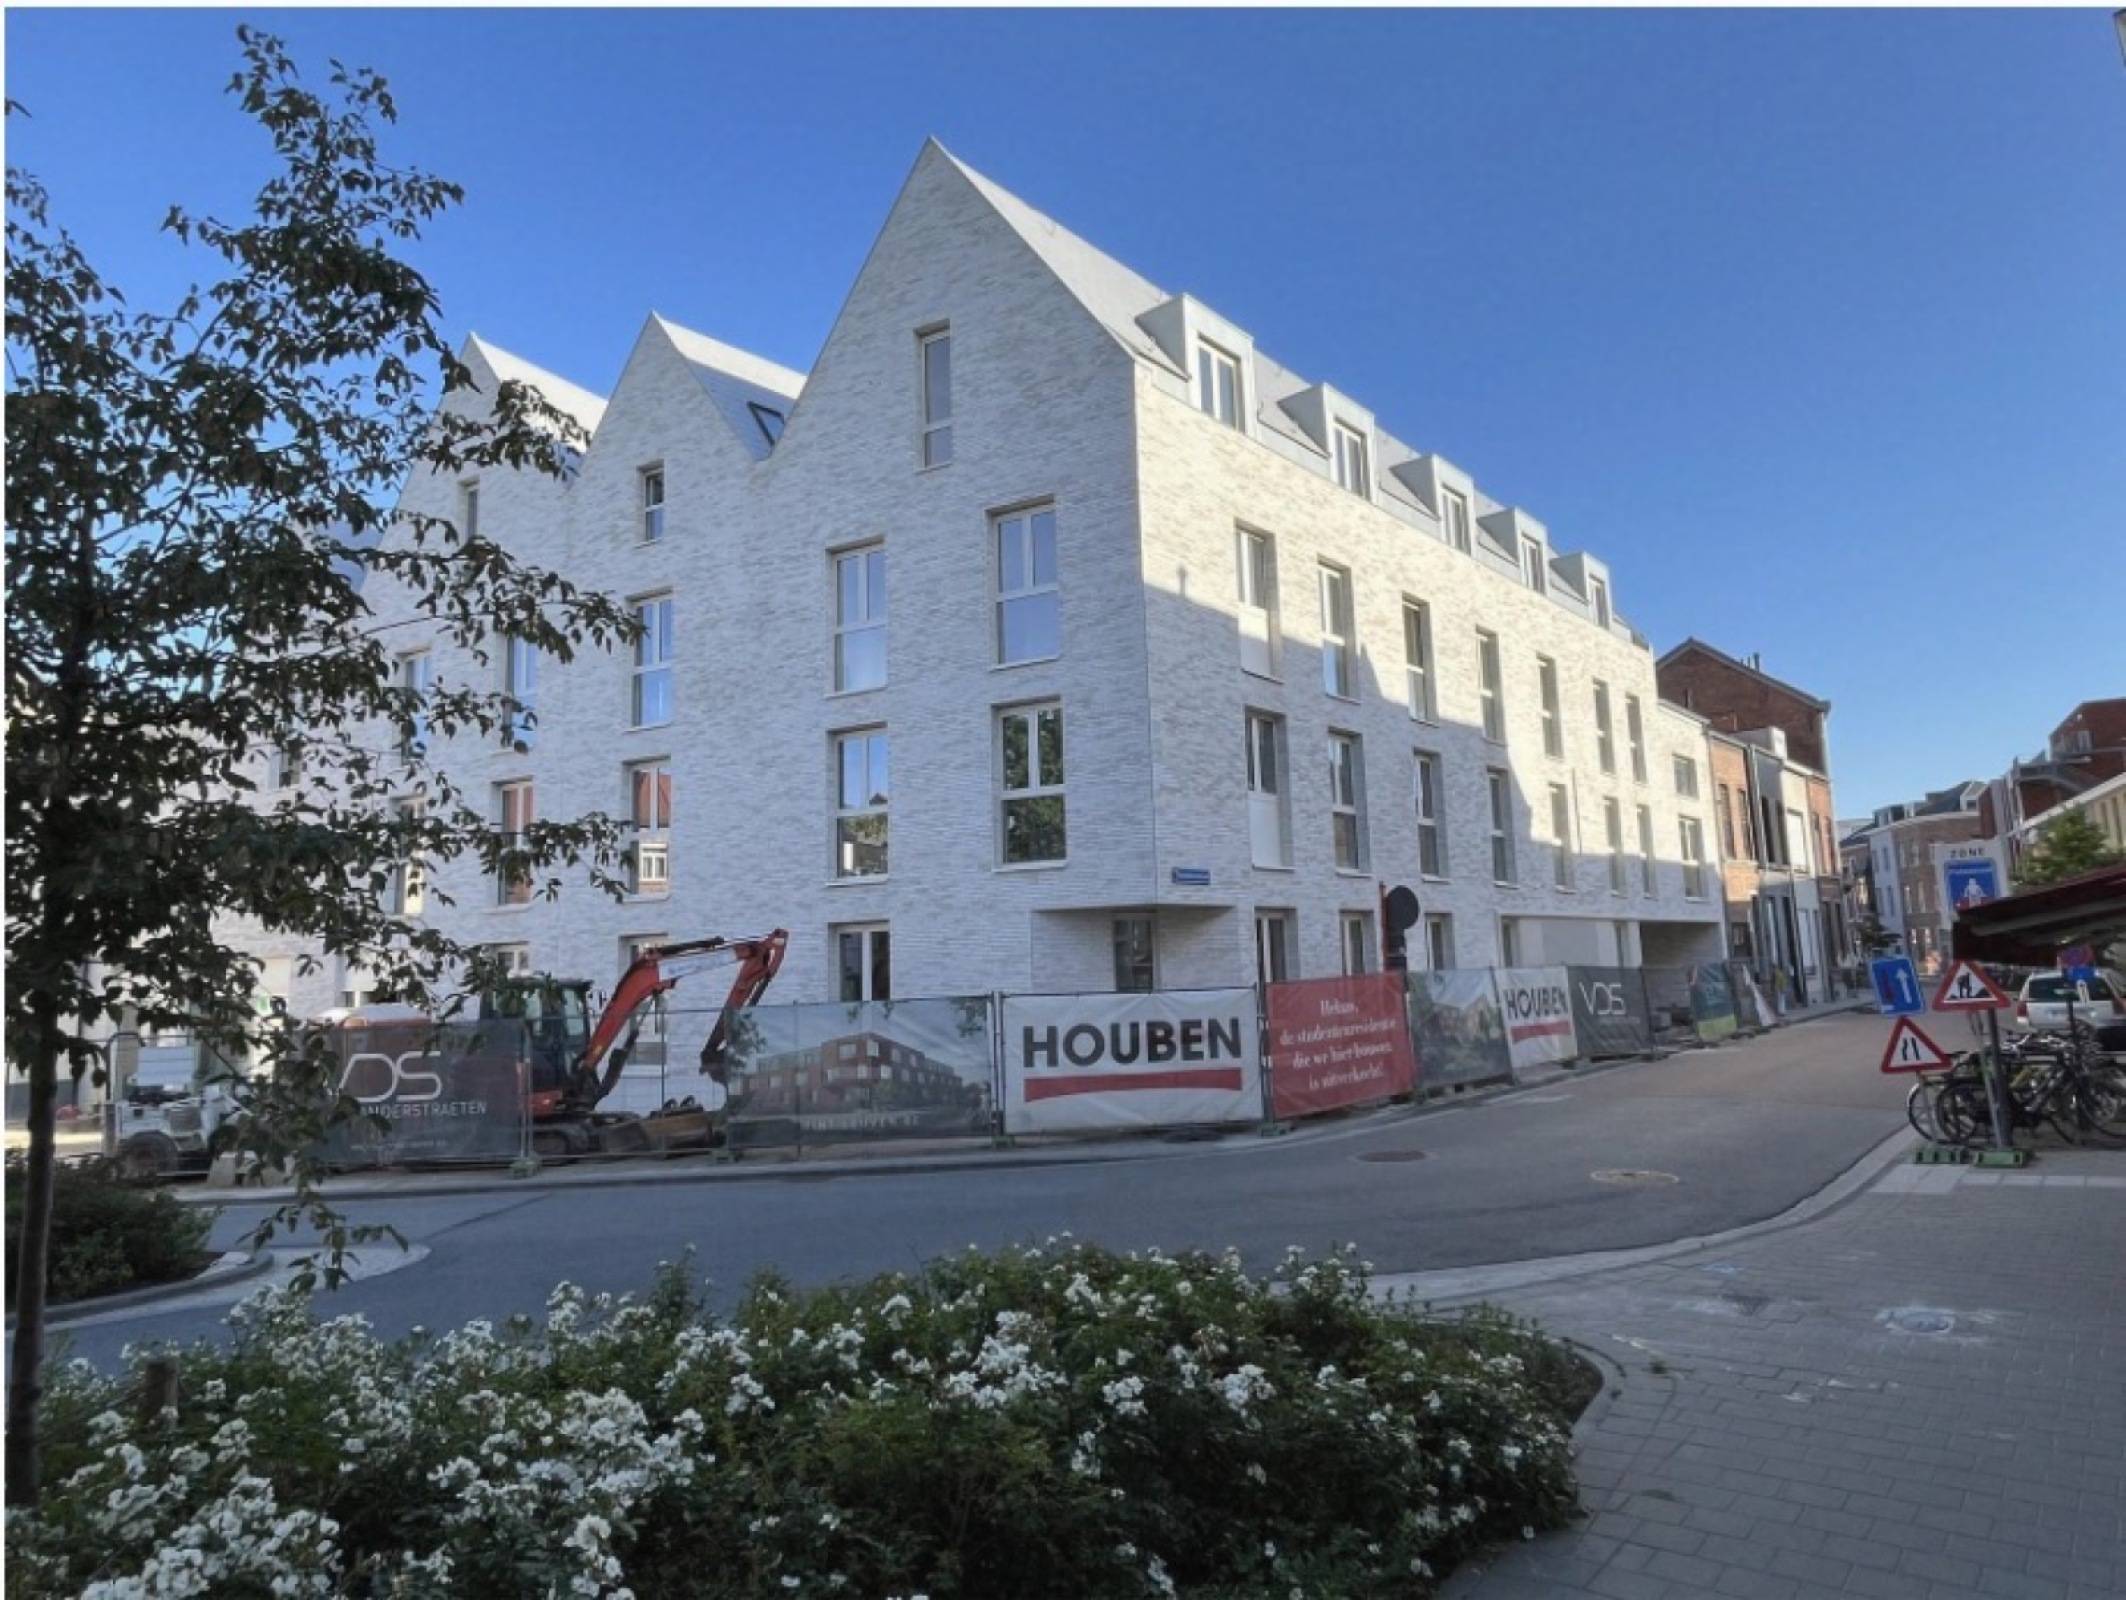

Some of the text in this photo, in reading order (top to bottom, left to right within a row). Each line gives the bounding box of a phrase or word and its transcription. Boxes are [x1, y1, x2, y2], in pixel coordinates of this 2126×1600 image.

[1950, 847, 1985, 858] ZONE
[1502, 986, 1568, 1019] HOUBEN
[1578, 981, 1627, 1015] VDS
[1023, 1017, 1242, 1068] HOUBEN
[358, 1100, 488, 1120] ANDERSTRAETEN
